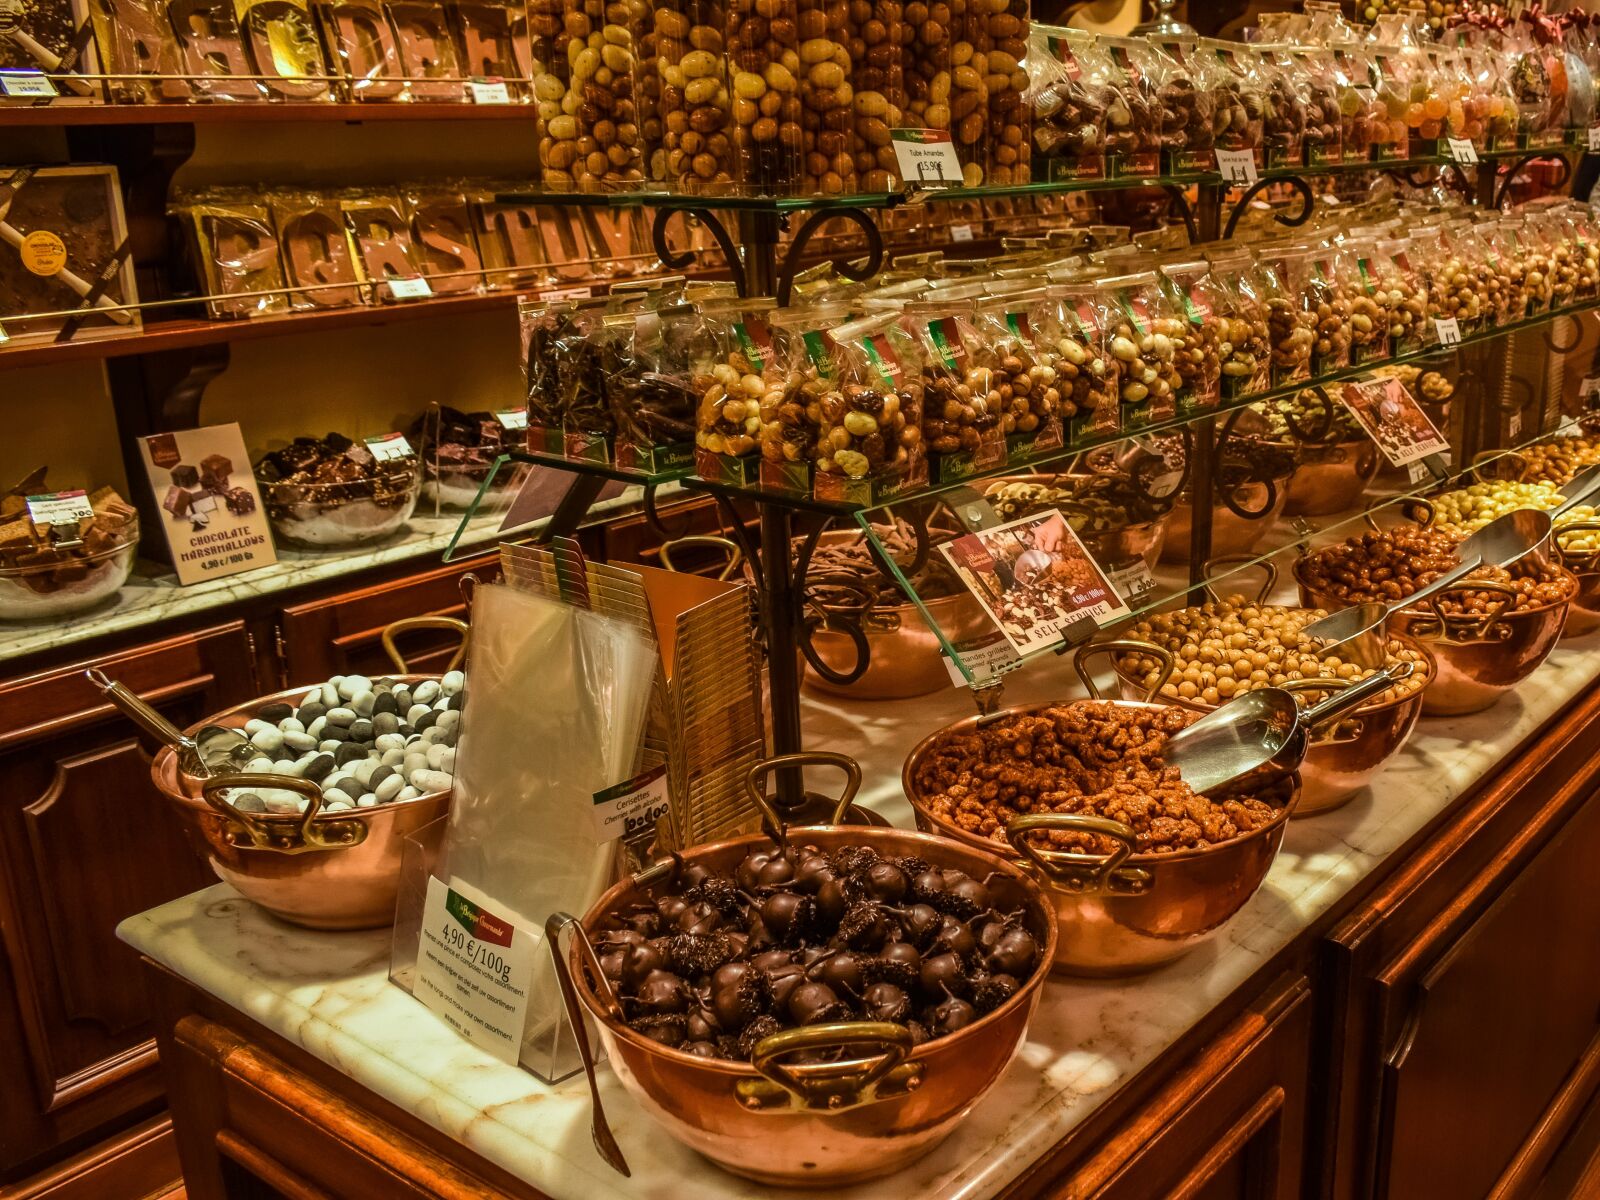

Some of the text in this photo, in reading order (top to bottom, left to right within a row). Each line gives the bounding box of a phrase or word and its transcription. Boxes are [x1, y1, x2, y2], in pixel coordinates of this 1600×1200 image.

[909, 149, 944, 157] Tube Amandes
[181, 535, 265, 562] MARSHMALLOWS
[190, 526, 251, 547] CHOCOLATE
[1034, 604, 1107, 639] SELF SERVICE
[959, 652, 986, 663] mandes
[604, 793, 662, 826] Cherries with alcohol
[616, 790, 650, 811] Cerisettes
[442, 923, 512, 983] 4,90 €/100g
[443, 944, 456, 957] pince
[460, 956, 482, 974] composez
[481, 970, 494, 981] votre
[452, 1000, 464, 1012] make
[463, 1008, 474, 1019] your
[473, 1016, 484, 1026] own
